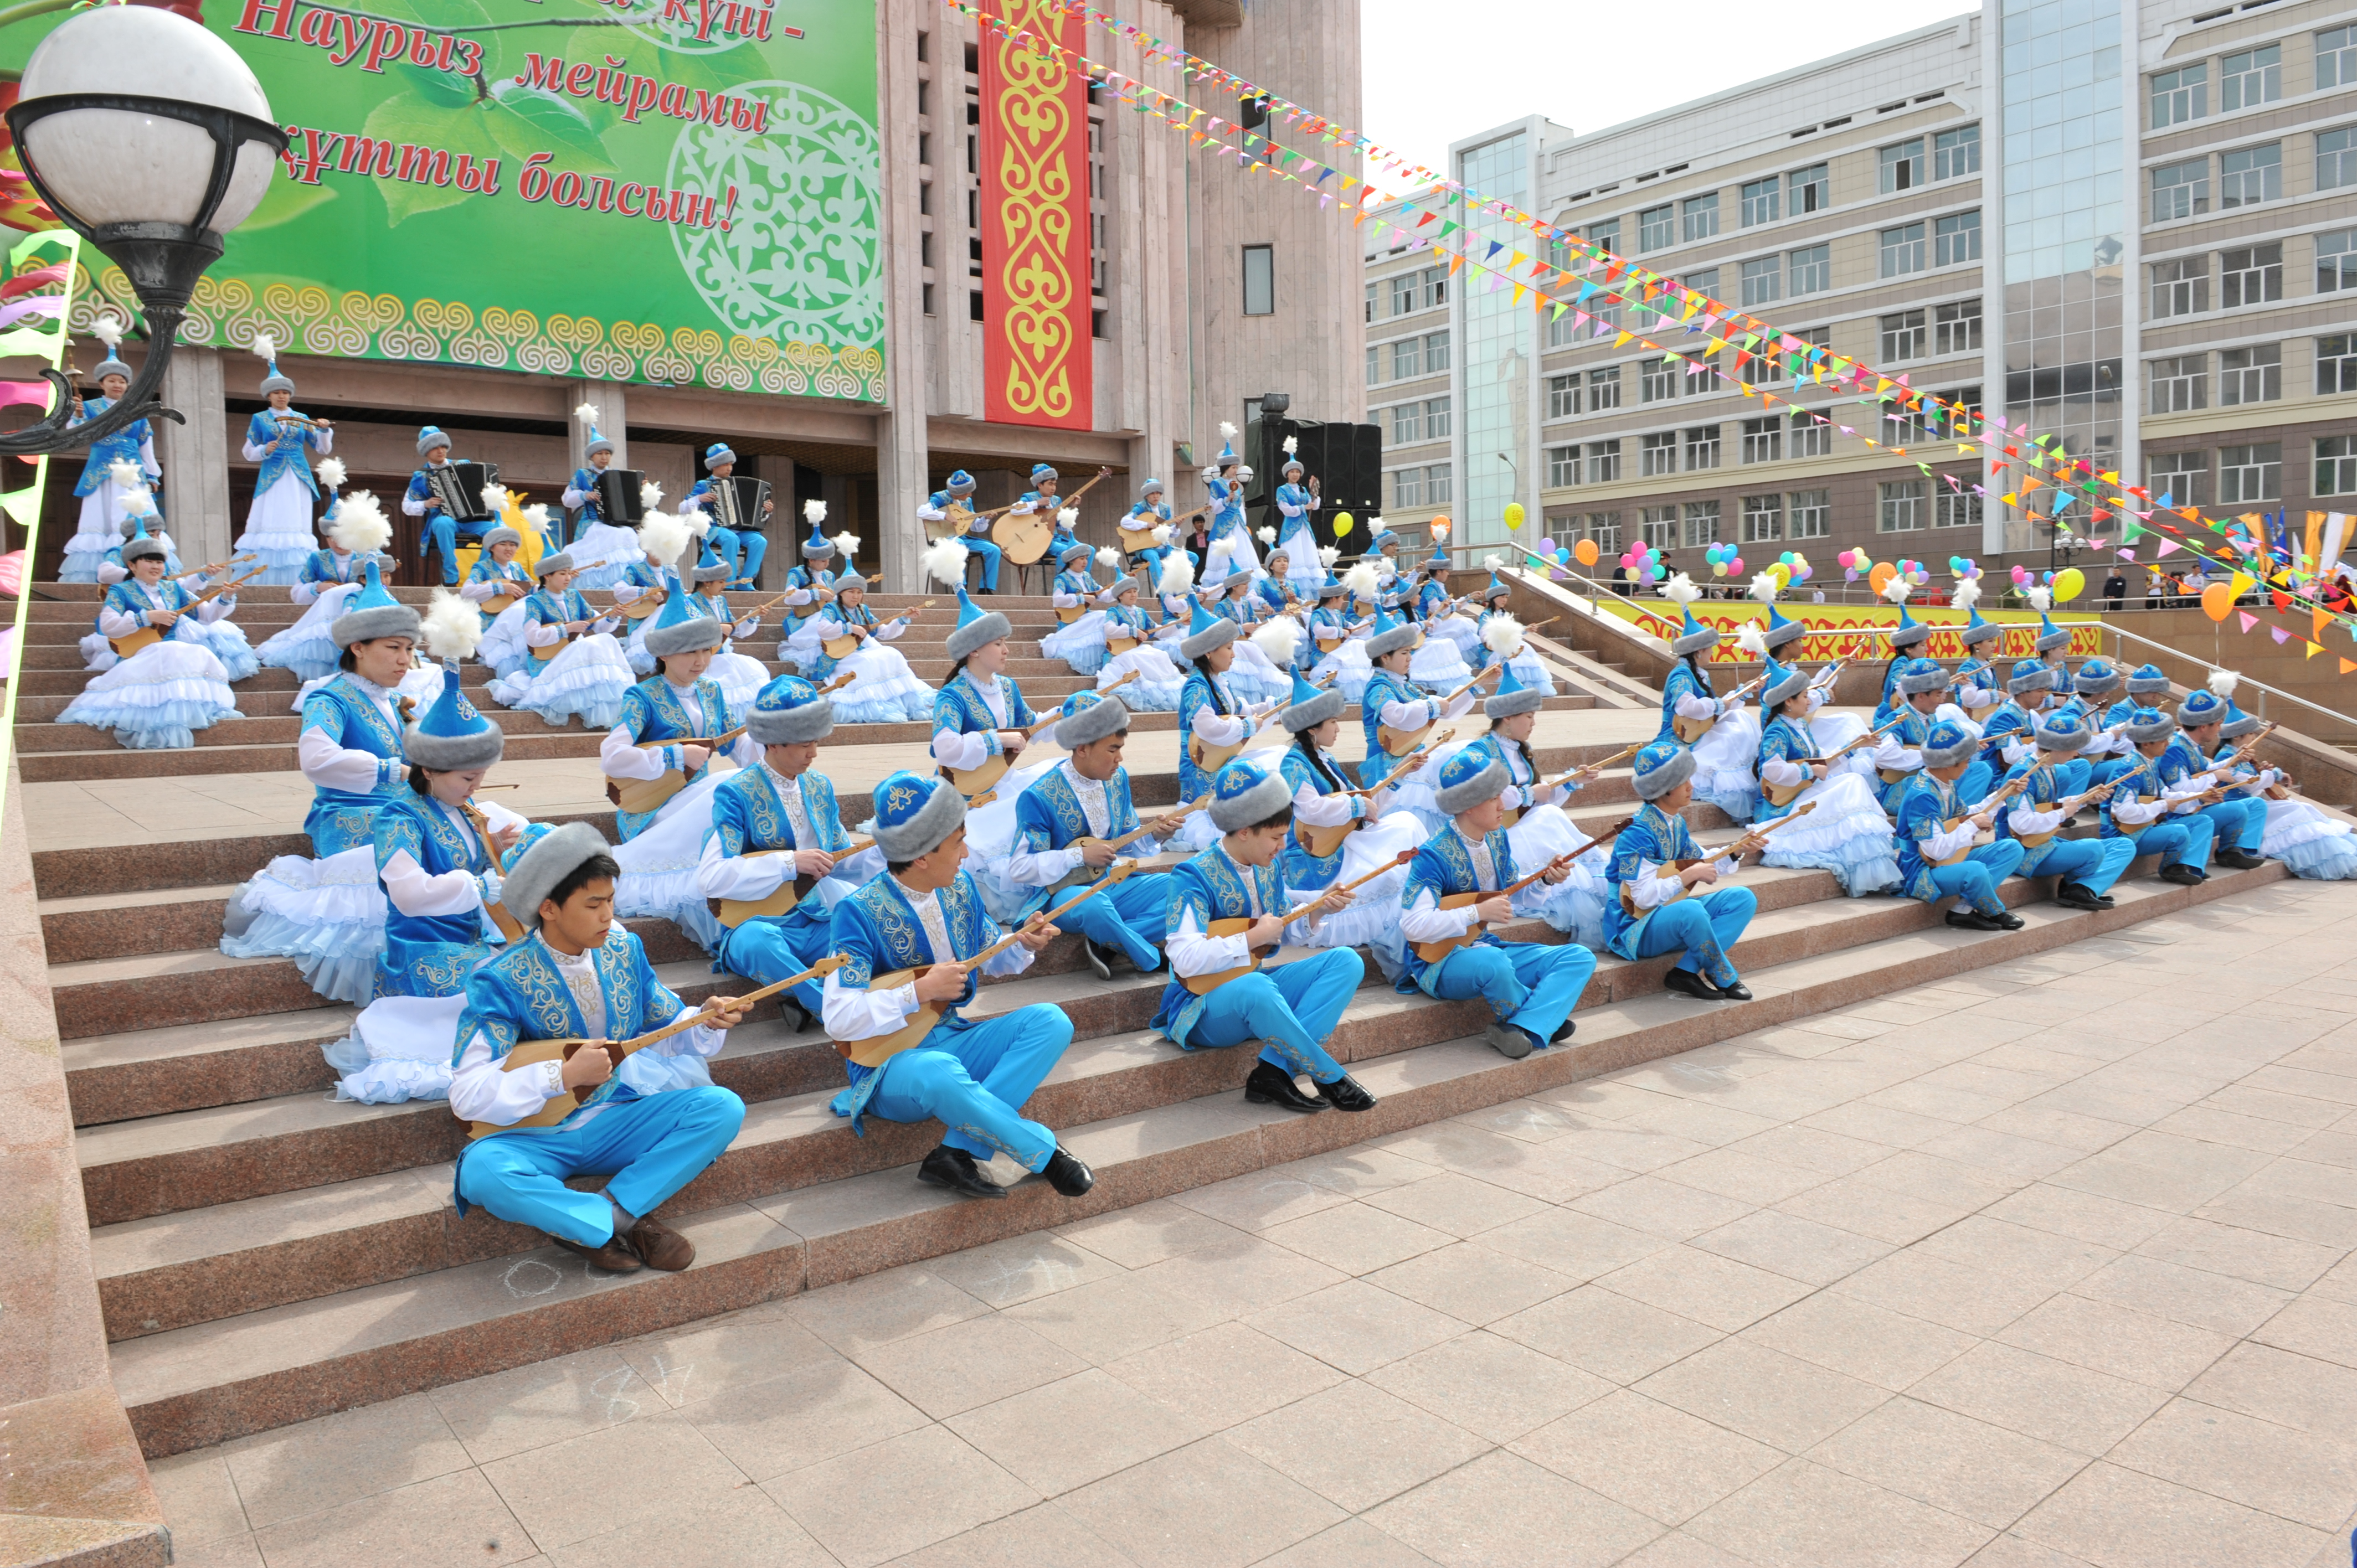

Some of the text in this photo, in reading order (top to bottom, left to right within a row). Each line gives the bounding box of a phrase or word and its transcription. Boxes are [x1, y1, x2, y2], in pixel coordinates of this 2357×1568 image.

[231, 0, 770, 135] Наурыз мейрамы
[518, 151, 739, 233] болсын!
